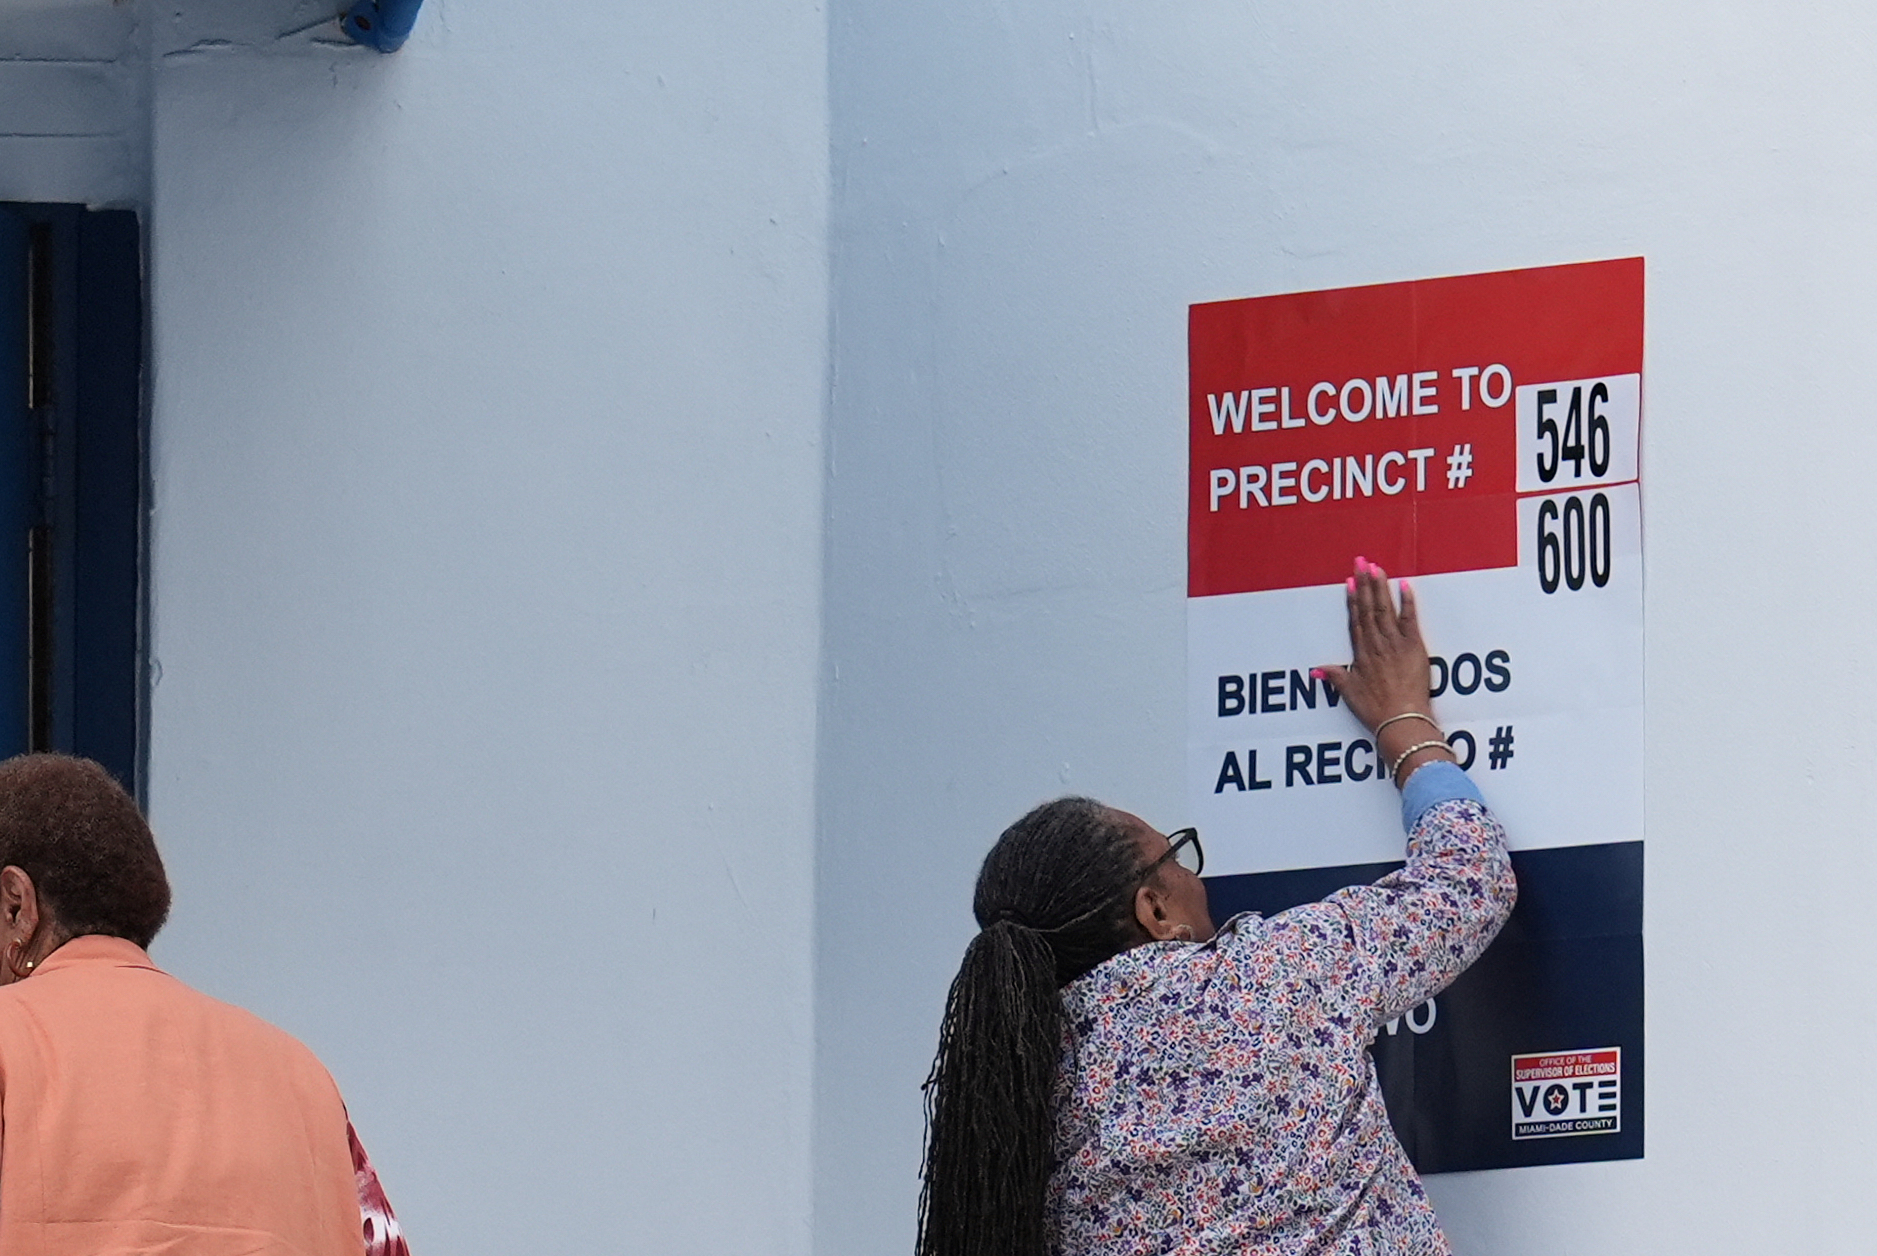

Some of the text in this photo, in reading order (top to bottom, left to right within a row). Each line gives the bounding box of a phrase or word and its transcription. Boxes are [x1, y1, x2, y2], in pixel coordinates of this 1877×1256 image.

[1207, 363, 1512, 435] WELCOME TO
[1536, 382, 1610, 483] 546
[1209, 443, 1473, 512] PRECINCT #
[1537, 493, 1611, 594] 600
[1214, 749, 1272, 794] AL
[1488, 725, 1515, 771] #
[1515, 1080, 1617, 1118] VOTE
[1516, 1062, 1616, 1080] SUPERVISOR OF ELECTIONS
[1518, 1119, 1613, 1134] MIAMI-DADE COUNTY
